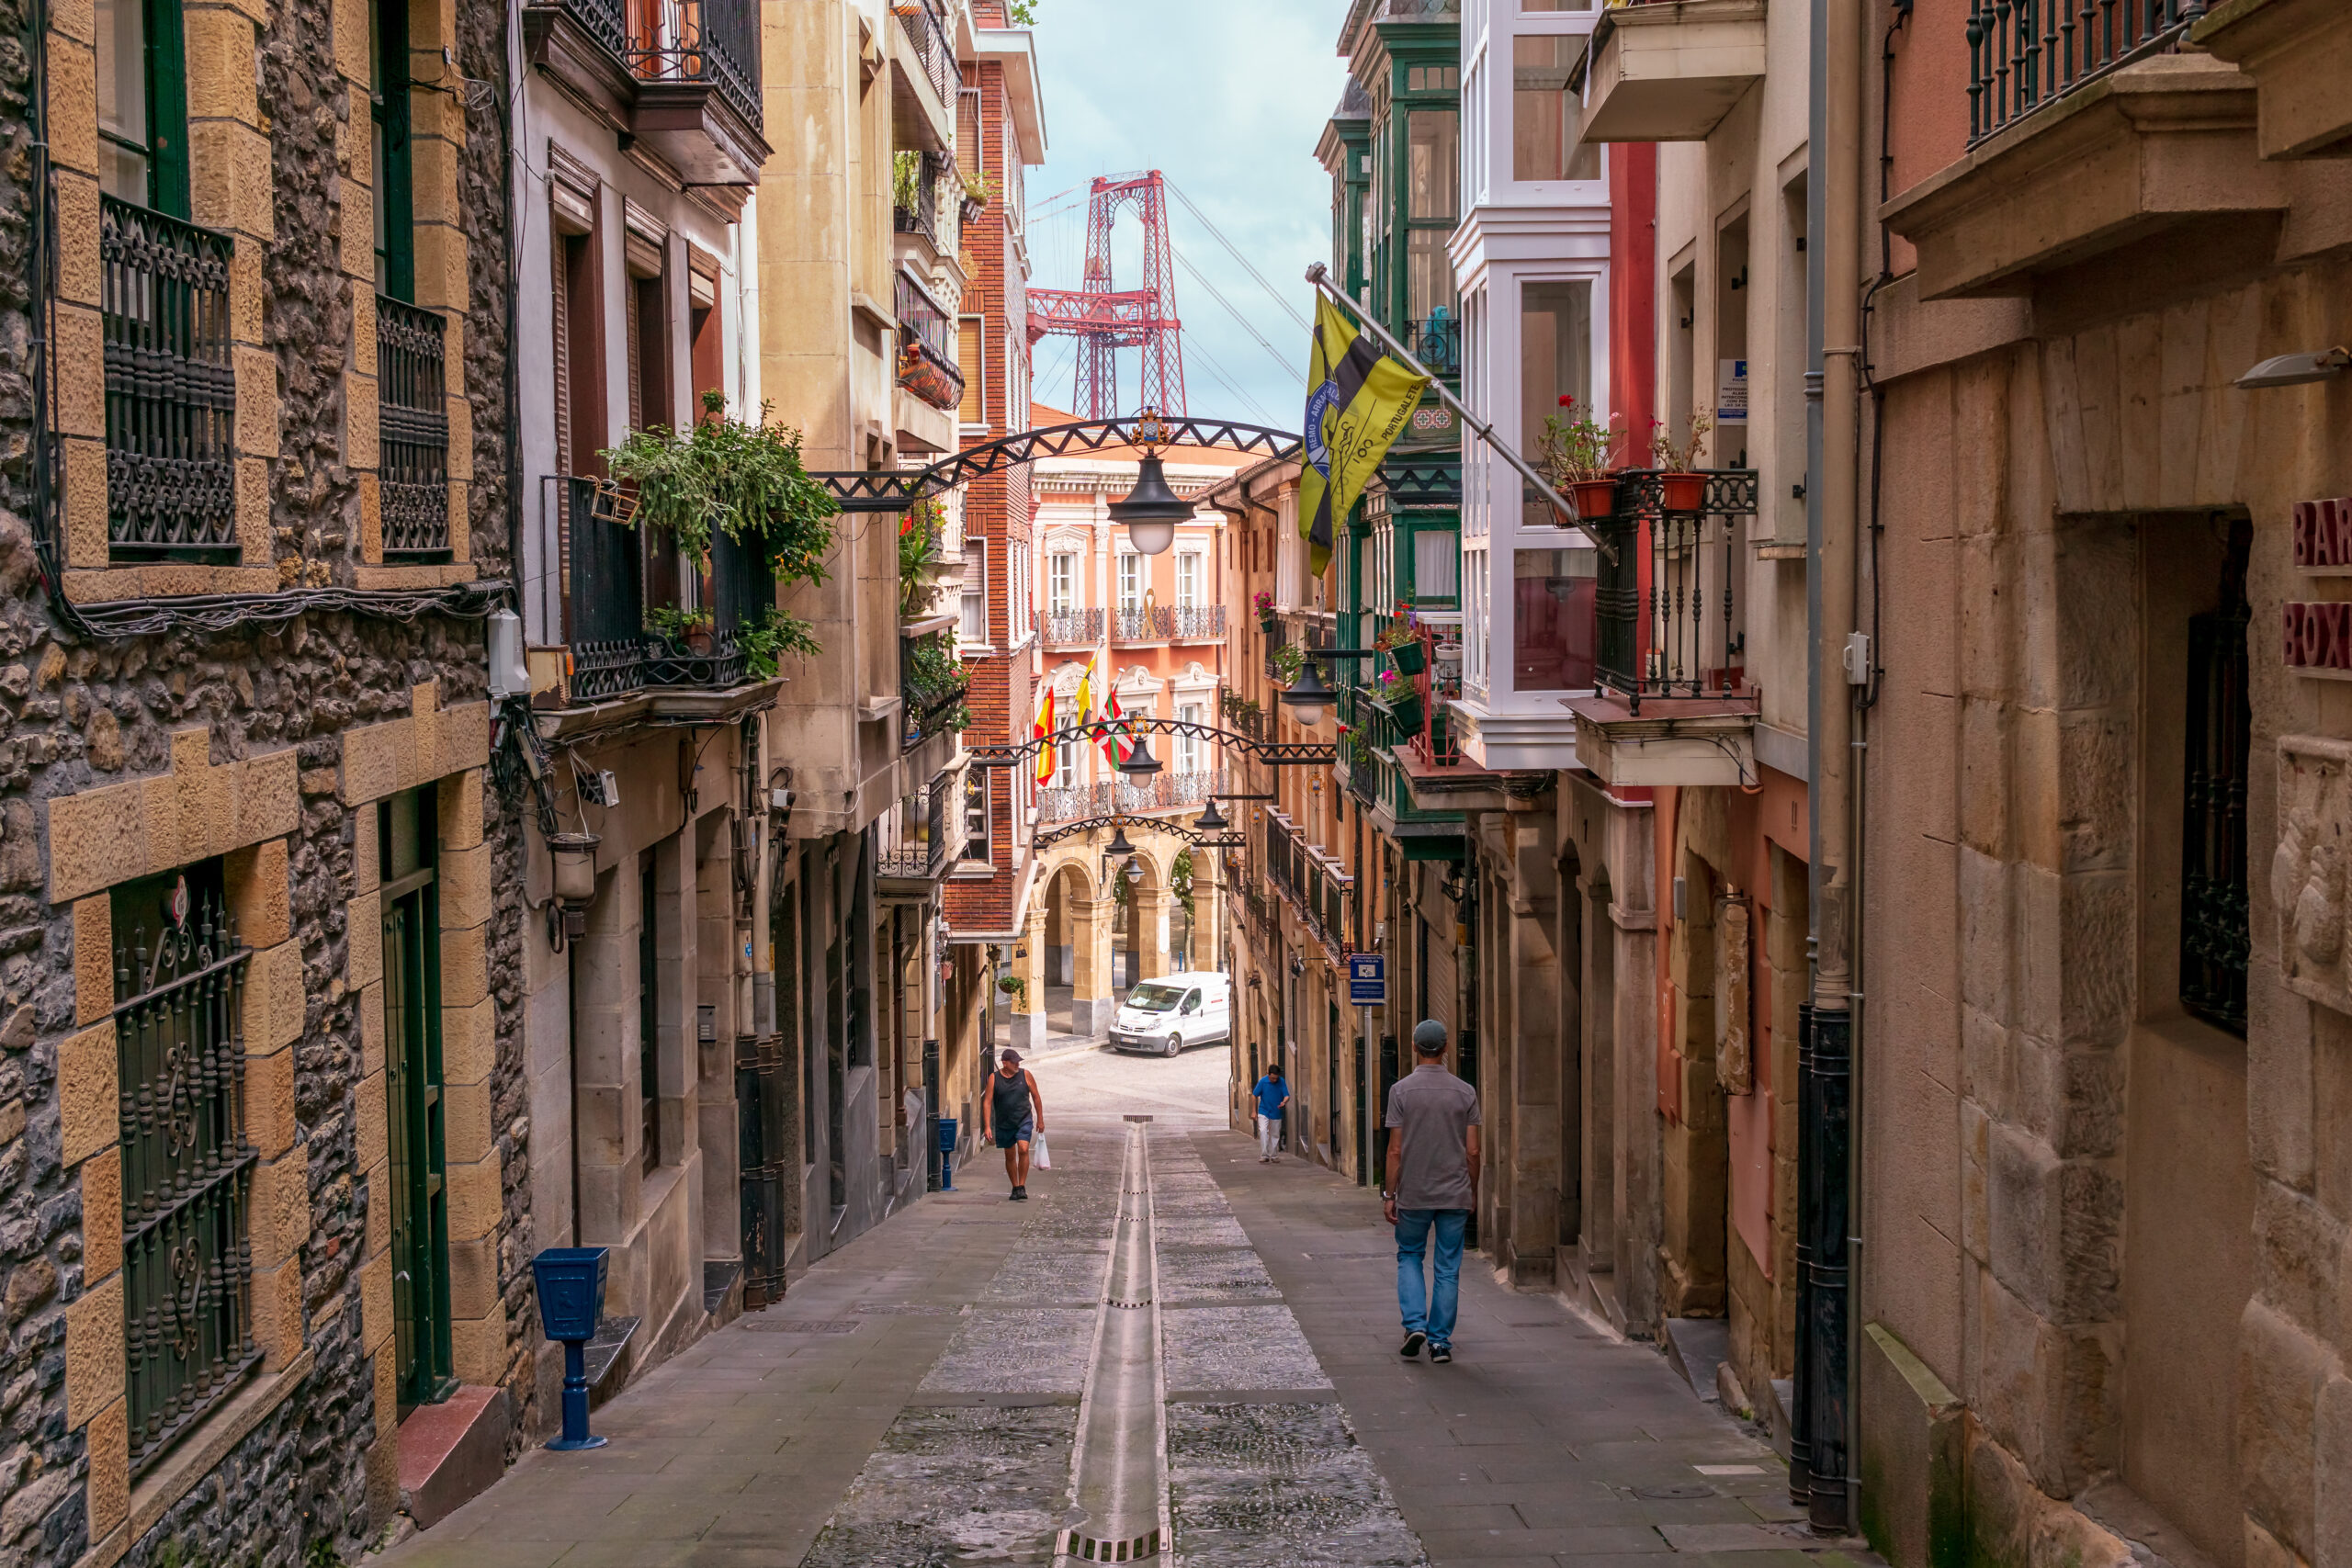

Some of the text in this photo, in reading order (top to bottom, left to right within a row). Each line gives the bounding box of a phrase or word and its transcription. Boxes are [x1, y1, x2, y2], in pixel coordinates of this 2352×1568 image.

[1381, 384, 1420, 441] PORTUGALETE
[1308, 423, 1318, 449] REMO
[1352, 439, 1374, 464] 100
[2293, 499, 2352, 566] BAR
